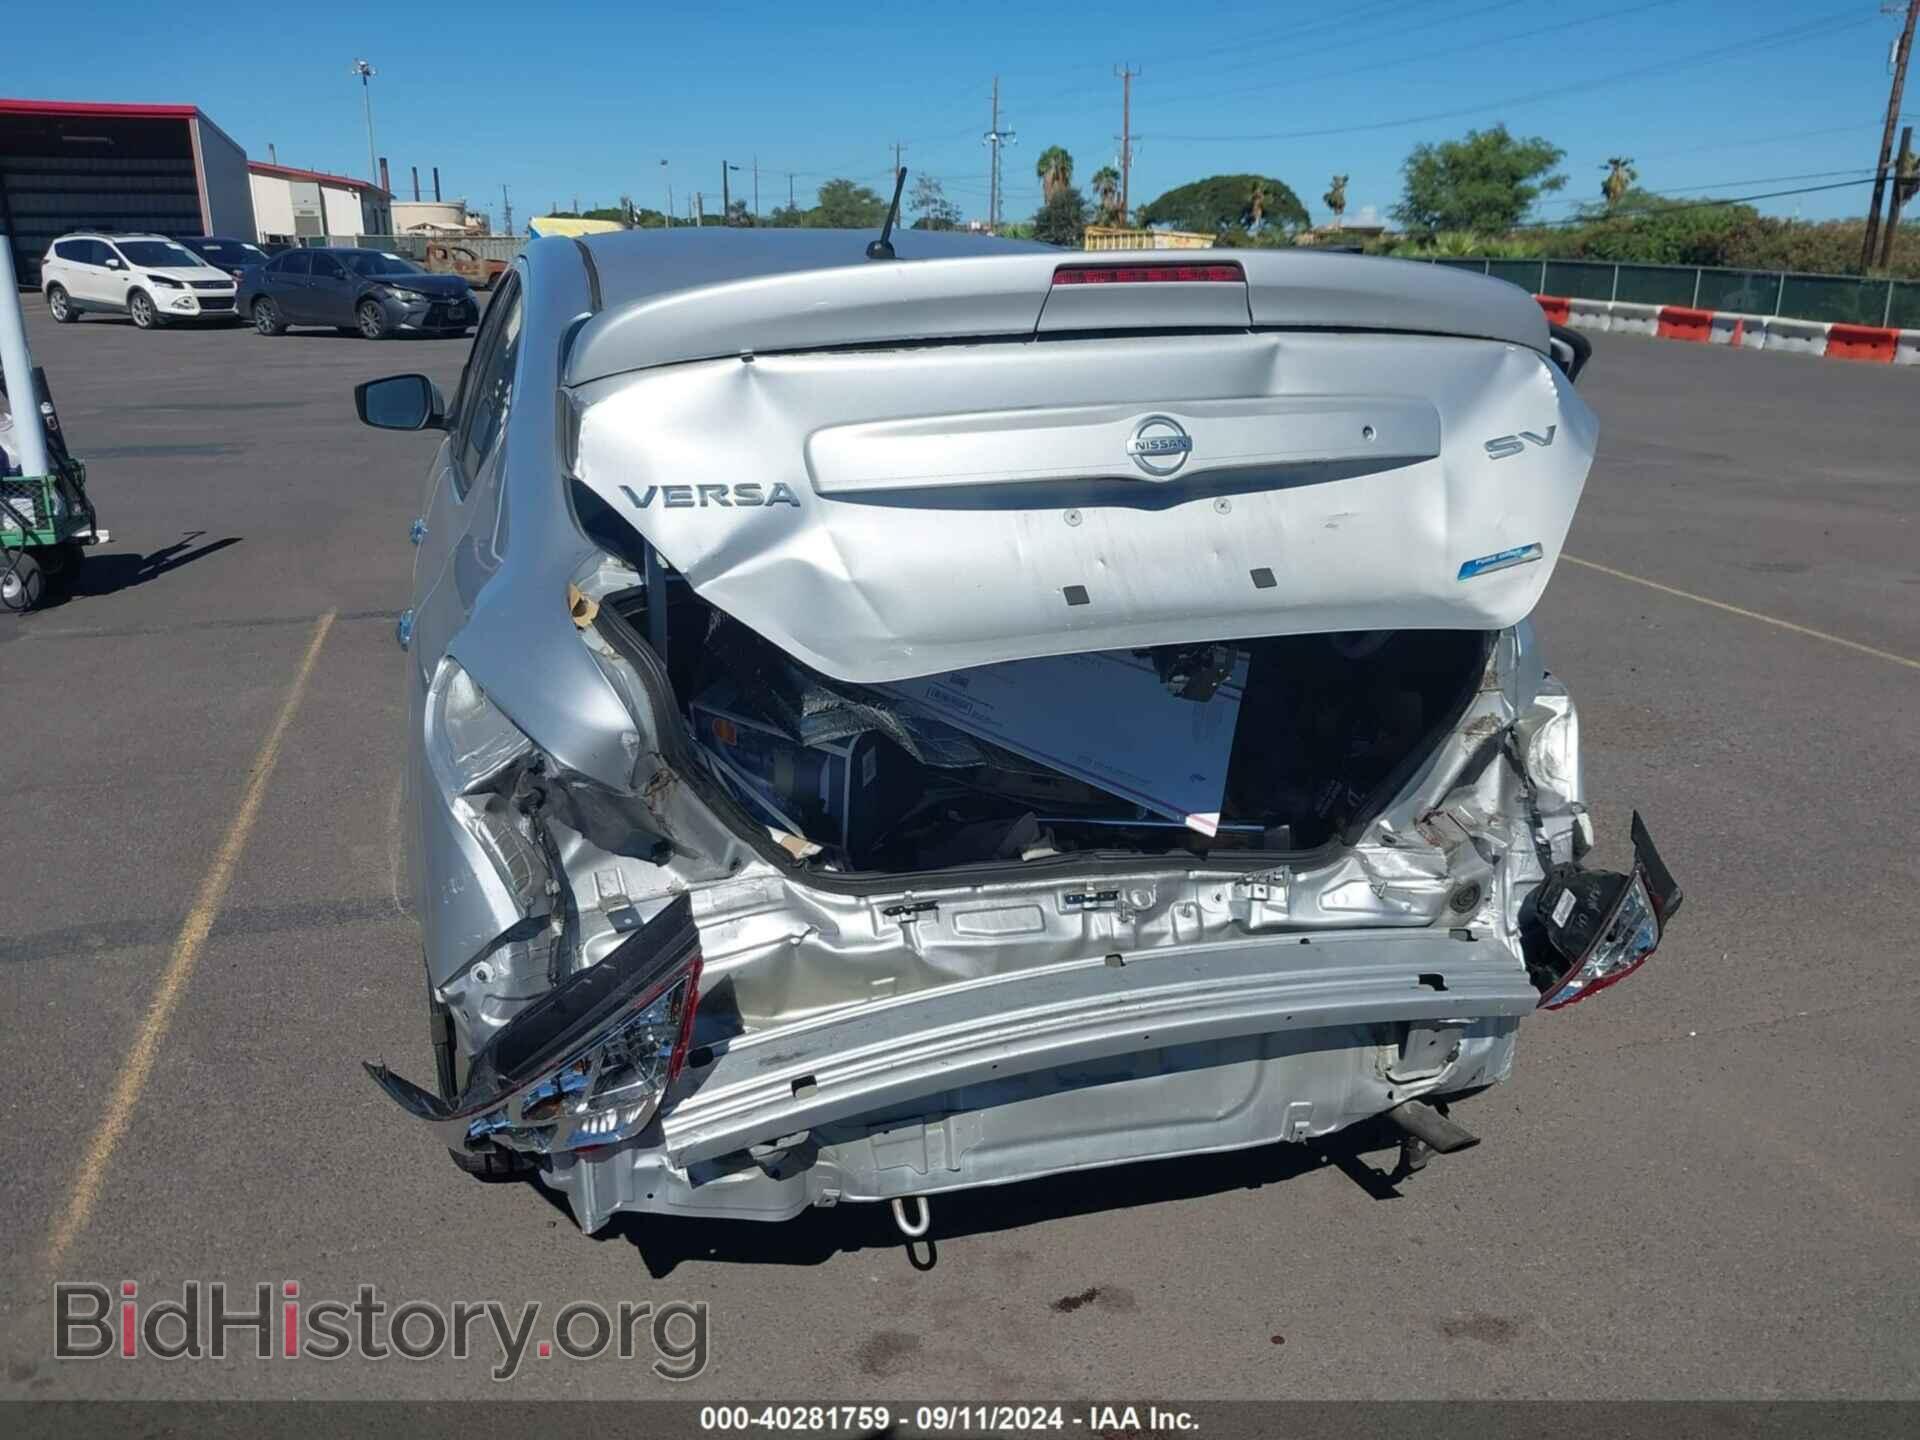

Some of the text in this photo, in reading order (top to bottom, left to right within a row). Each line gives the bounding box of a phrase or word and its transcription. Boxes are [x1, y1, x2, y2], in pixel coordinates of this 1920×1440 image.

[1135, 439, 1187, 450] NISSAN
[1484, 424, 1557, 460] SV
[618, 482, 802, 508] VERSA
